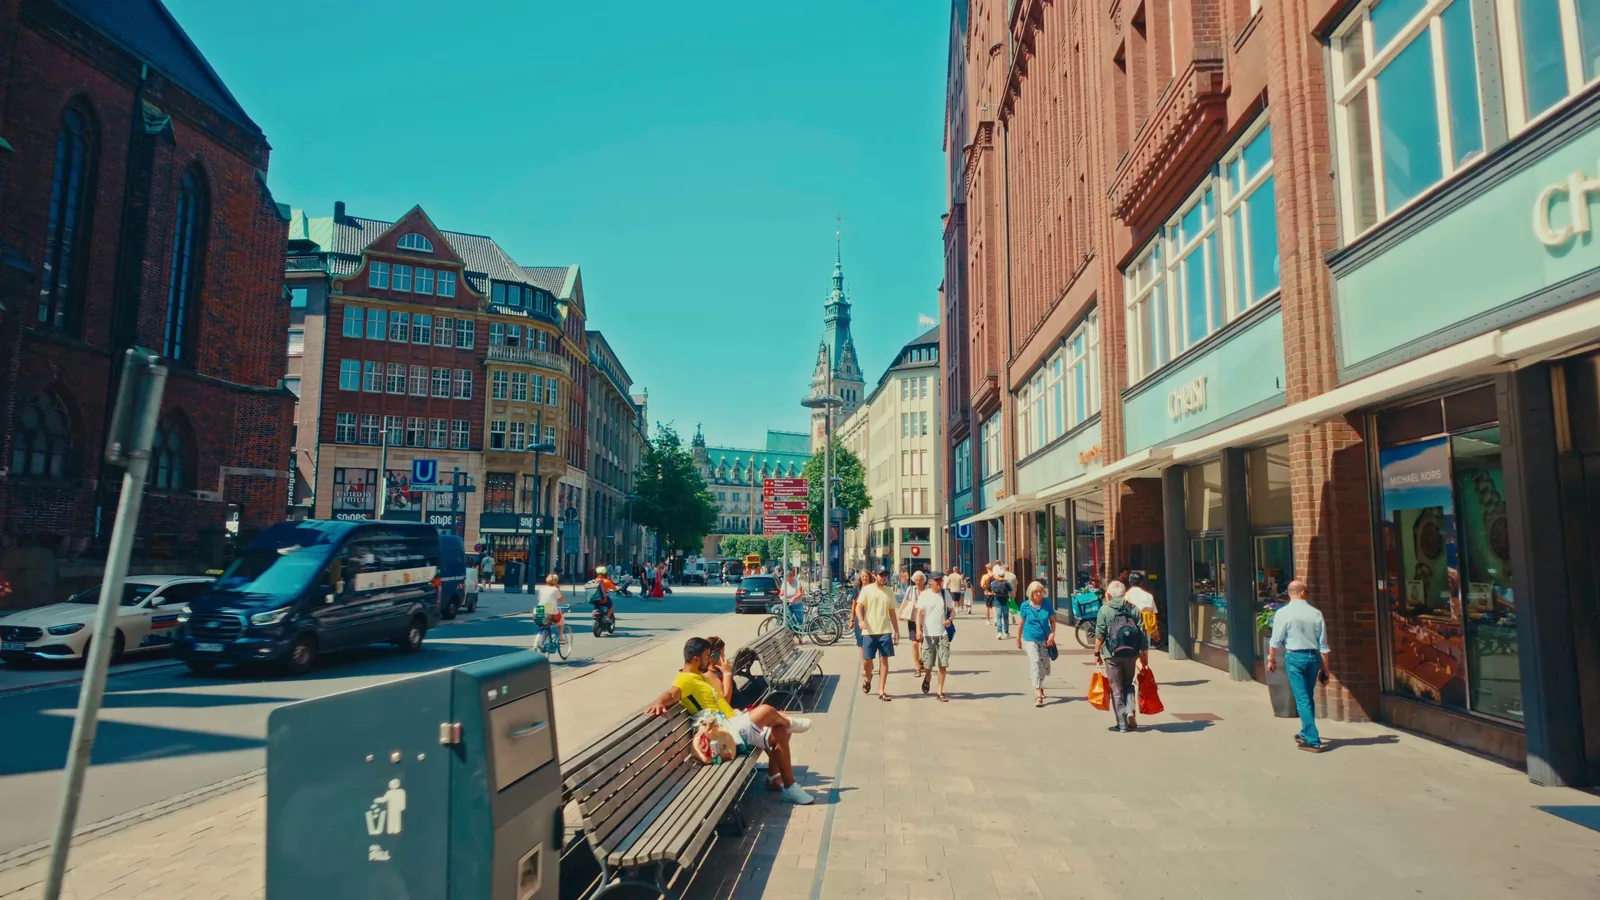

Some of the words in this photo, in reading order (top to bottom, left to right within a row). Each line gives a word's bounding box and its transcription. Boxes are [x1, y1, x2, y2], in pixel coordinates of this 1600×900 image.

[415, 461, 433, 482] U
[1390, 473, 1419, 485] MICHAEL
[1421, 469, 1442, 481] KORS
[288, 469, 296, 506] prediger
[429, 515, 458, 527] snipe
[520, 517, 541, 528] snips
[959, 524, 970, 538] U
